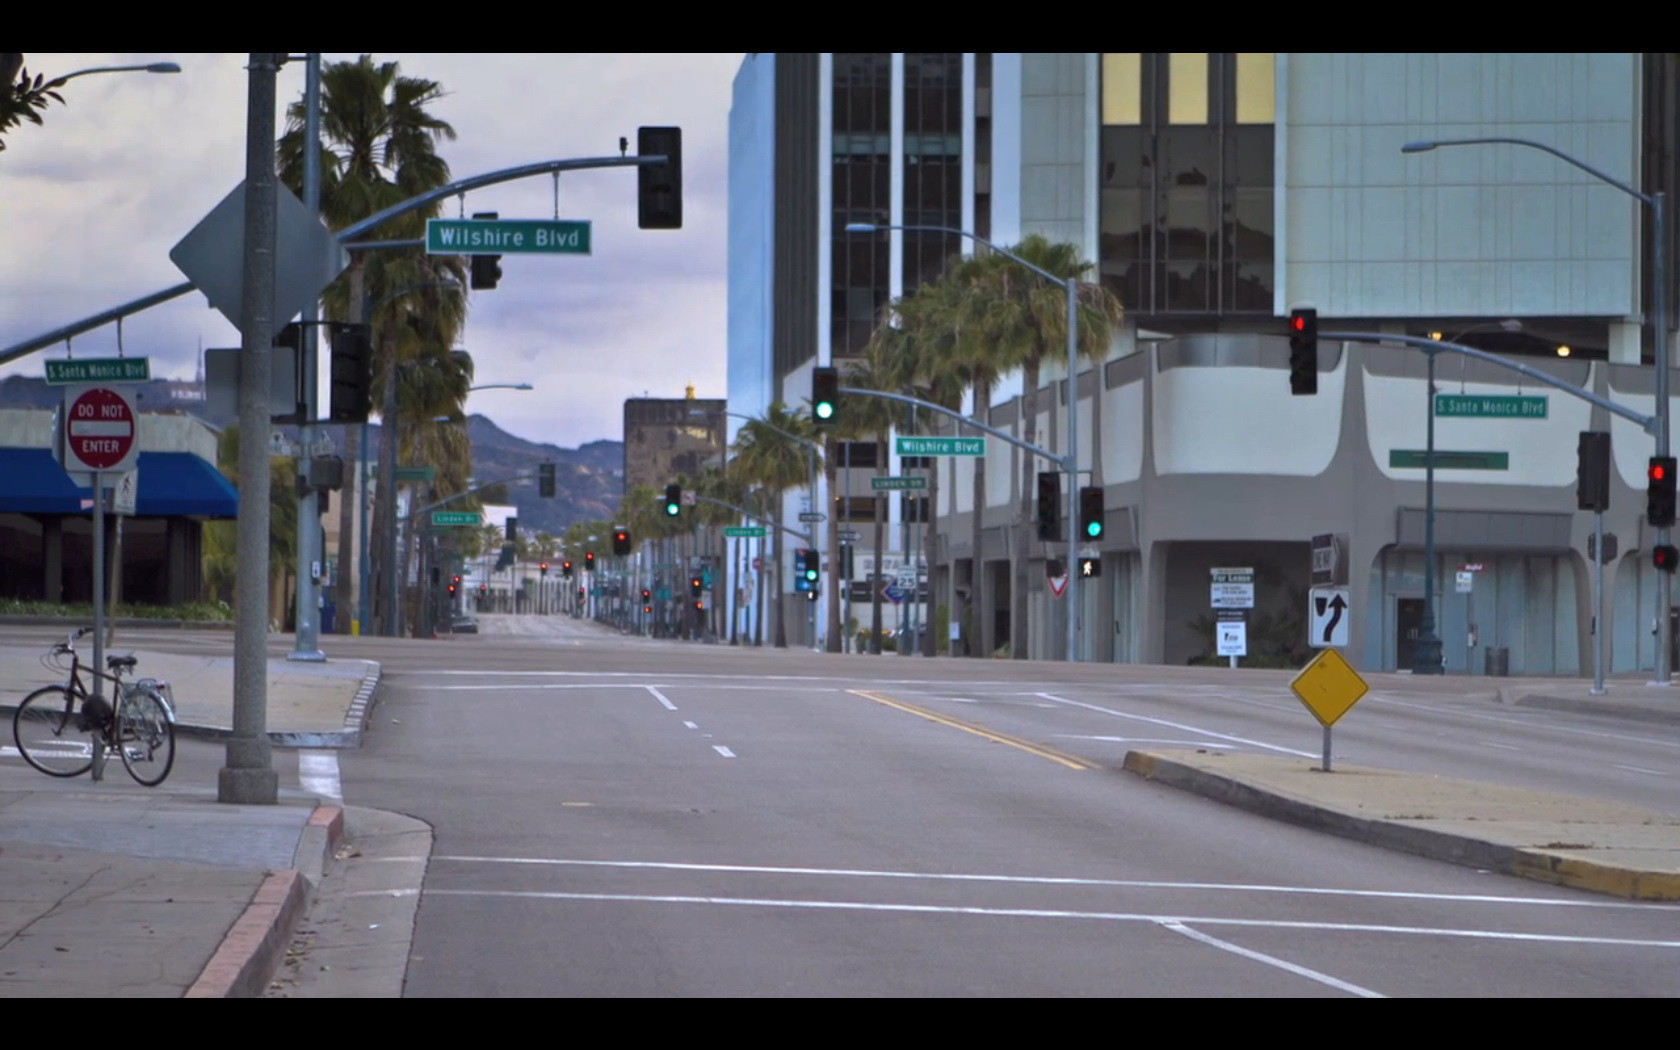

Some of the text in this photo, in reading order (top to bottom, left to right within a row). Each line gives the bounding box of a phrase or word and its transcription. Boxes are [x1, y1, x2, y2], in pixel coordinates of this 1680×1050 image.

[440, 228, 579, 247] Wilshire Blvd
[58, 365, 86, 378] Santa
[89, 364, 121, 377] Monica
[125, 362, 145, 376] Blvd
[78, 404, 124, 417] DO NOT
[1448, 400, 1478, 413] Santa
[1482, 400, 1518, 414] Monica
[1522, 402, 1544, 415] Blvd
[82, 440, 119, 453] ENTER
[902, 441, 979, 453] Wilshire Blvd
[899, 577, 915, 587] 25
